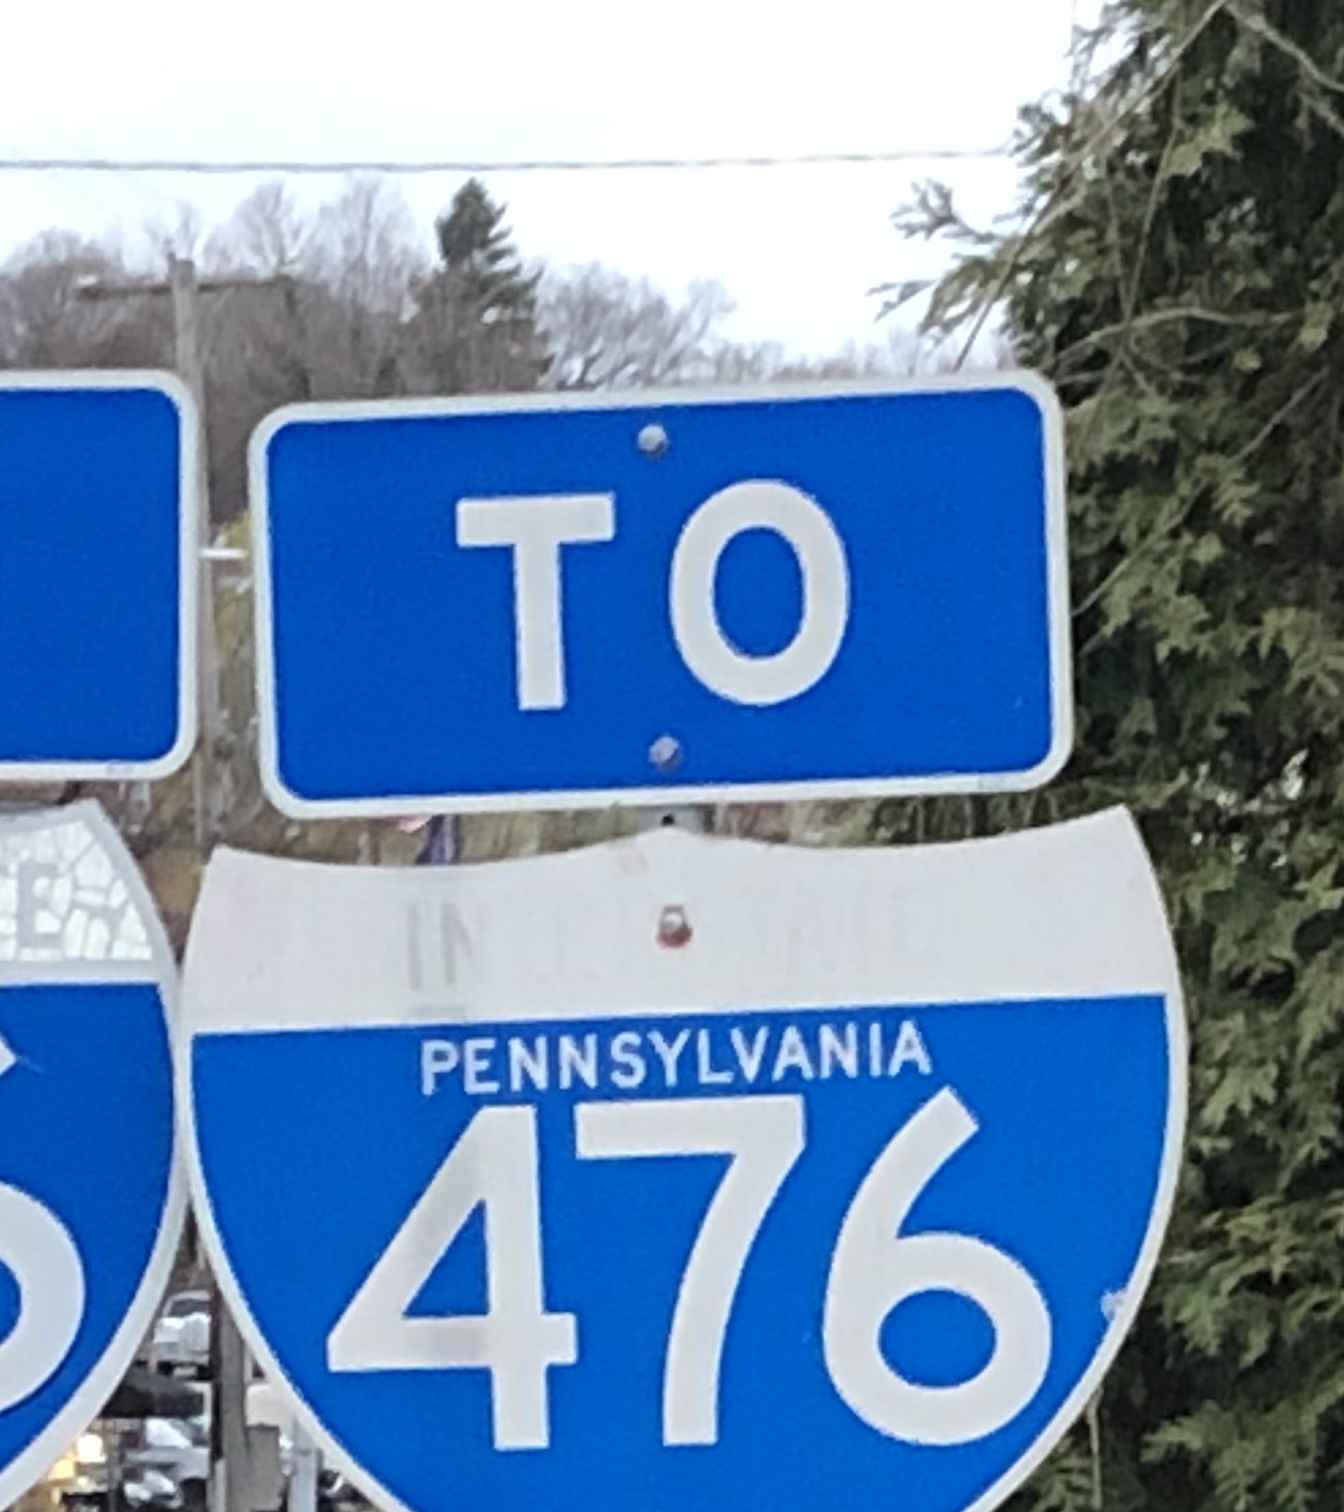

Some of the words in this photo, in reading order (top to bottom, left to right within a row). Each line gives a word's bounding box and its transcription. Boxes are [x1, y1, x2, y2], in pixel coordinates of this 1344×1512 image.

[455, 479, 850, 711] TO
[420, 1021, 932, 1096] PENNSYLVANIA
[326, 1086, 1053, 1451] 476
